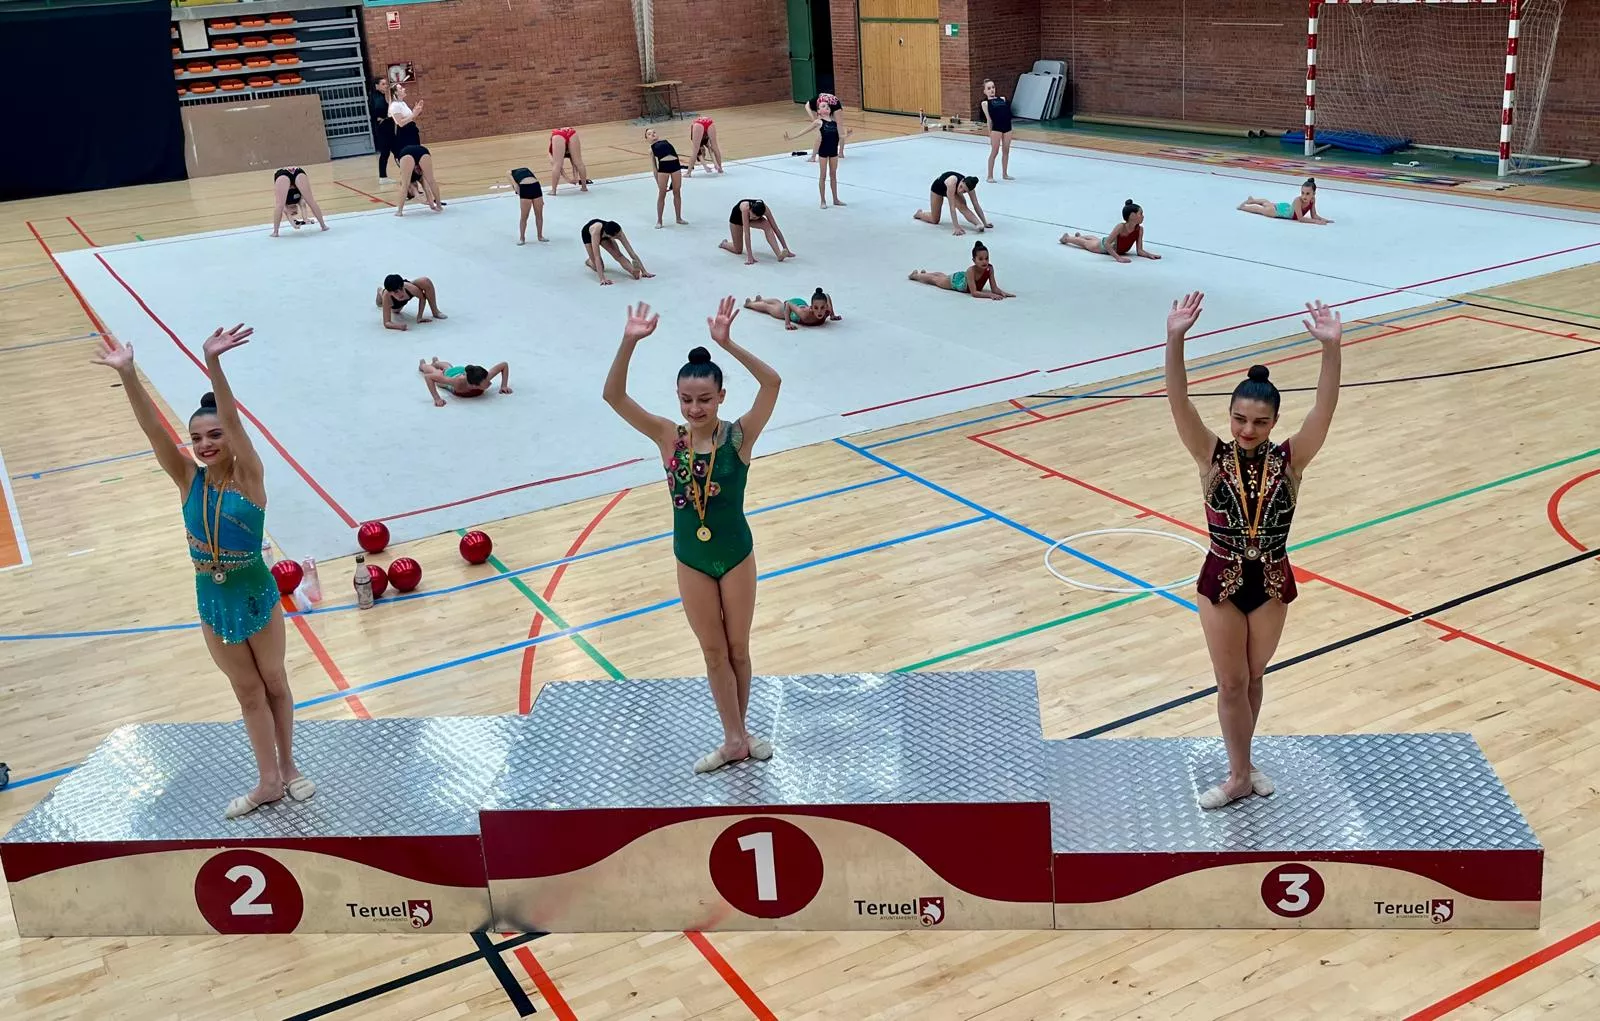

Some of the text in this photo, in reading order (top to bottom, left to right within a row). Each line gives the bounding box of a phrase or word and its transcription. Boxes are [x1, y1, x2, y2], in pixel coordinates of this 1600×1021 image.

[737, 831, 778, 901] 1
[224, 864, 274, 916] 2
[1276, 873, 1310, 912] 3
[346, 901, 407, 917] Teruel
[854, 899, 917, 915] Teruel
[1374, 901, 1429, 914] Teruel
